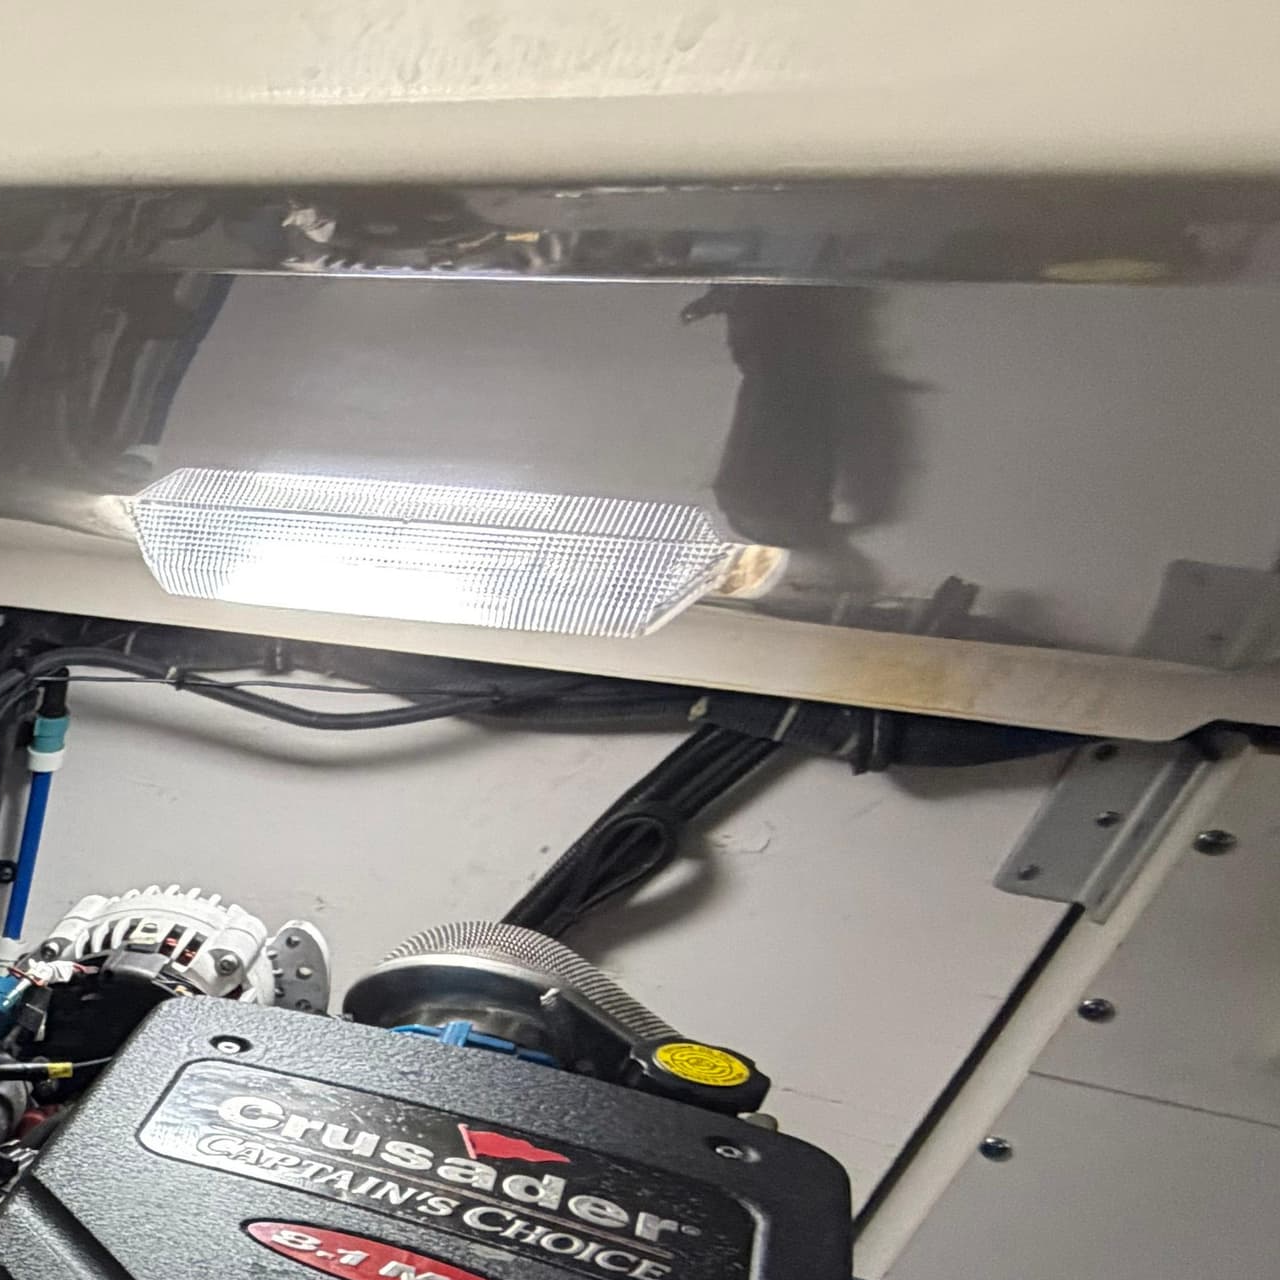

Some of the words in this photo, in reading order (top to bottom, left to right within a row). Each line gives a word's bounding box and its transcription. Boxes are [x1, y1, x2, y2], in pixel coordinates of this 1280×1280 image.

[196, 1132, 457, 1218] CAPTAIN'S
[218, 1095, 680, 1242] Crusader
[270, 1228, 369, 1265] 8.1
